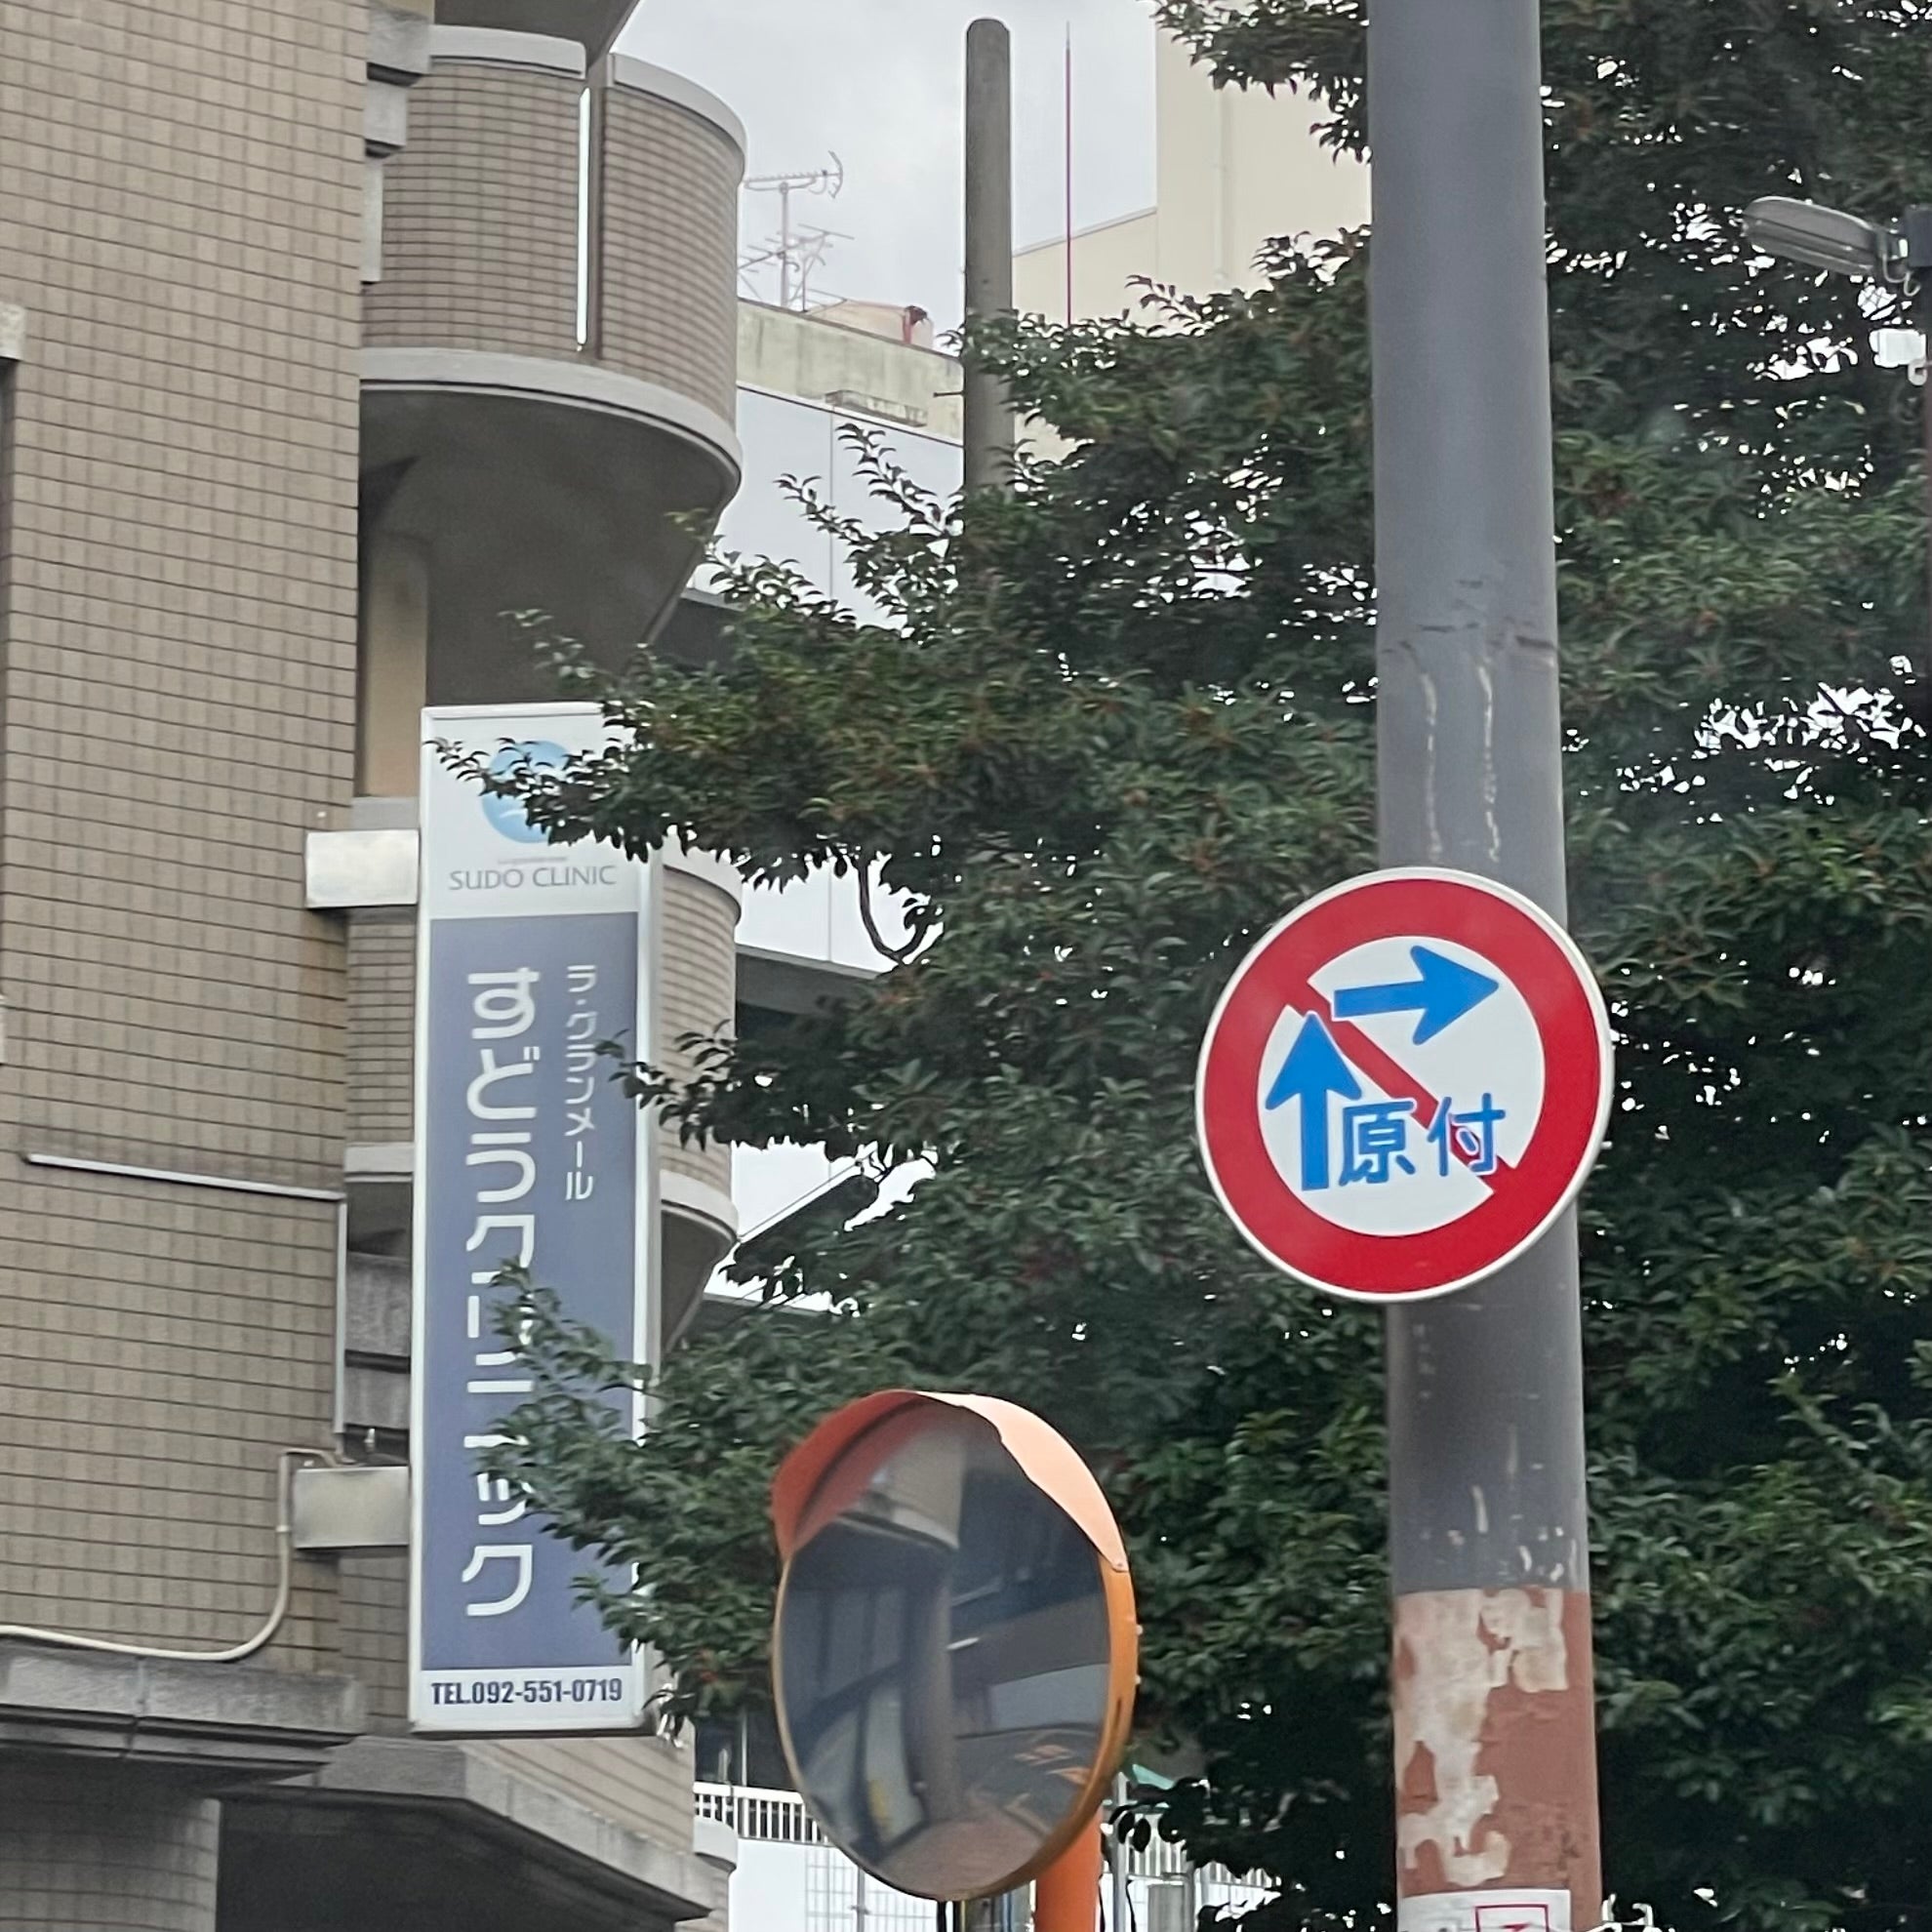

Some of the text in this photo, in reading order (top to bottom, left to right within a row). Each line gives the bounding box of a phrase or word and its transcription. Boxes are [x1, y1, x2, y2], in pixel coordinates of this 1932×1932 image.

[449, 865, 618, 891] SUDO CLINIC
[1338, 1092, 1507, 1185] 原付
[430, 1677, 624, 1706] TEL.092-551-0719
